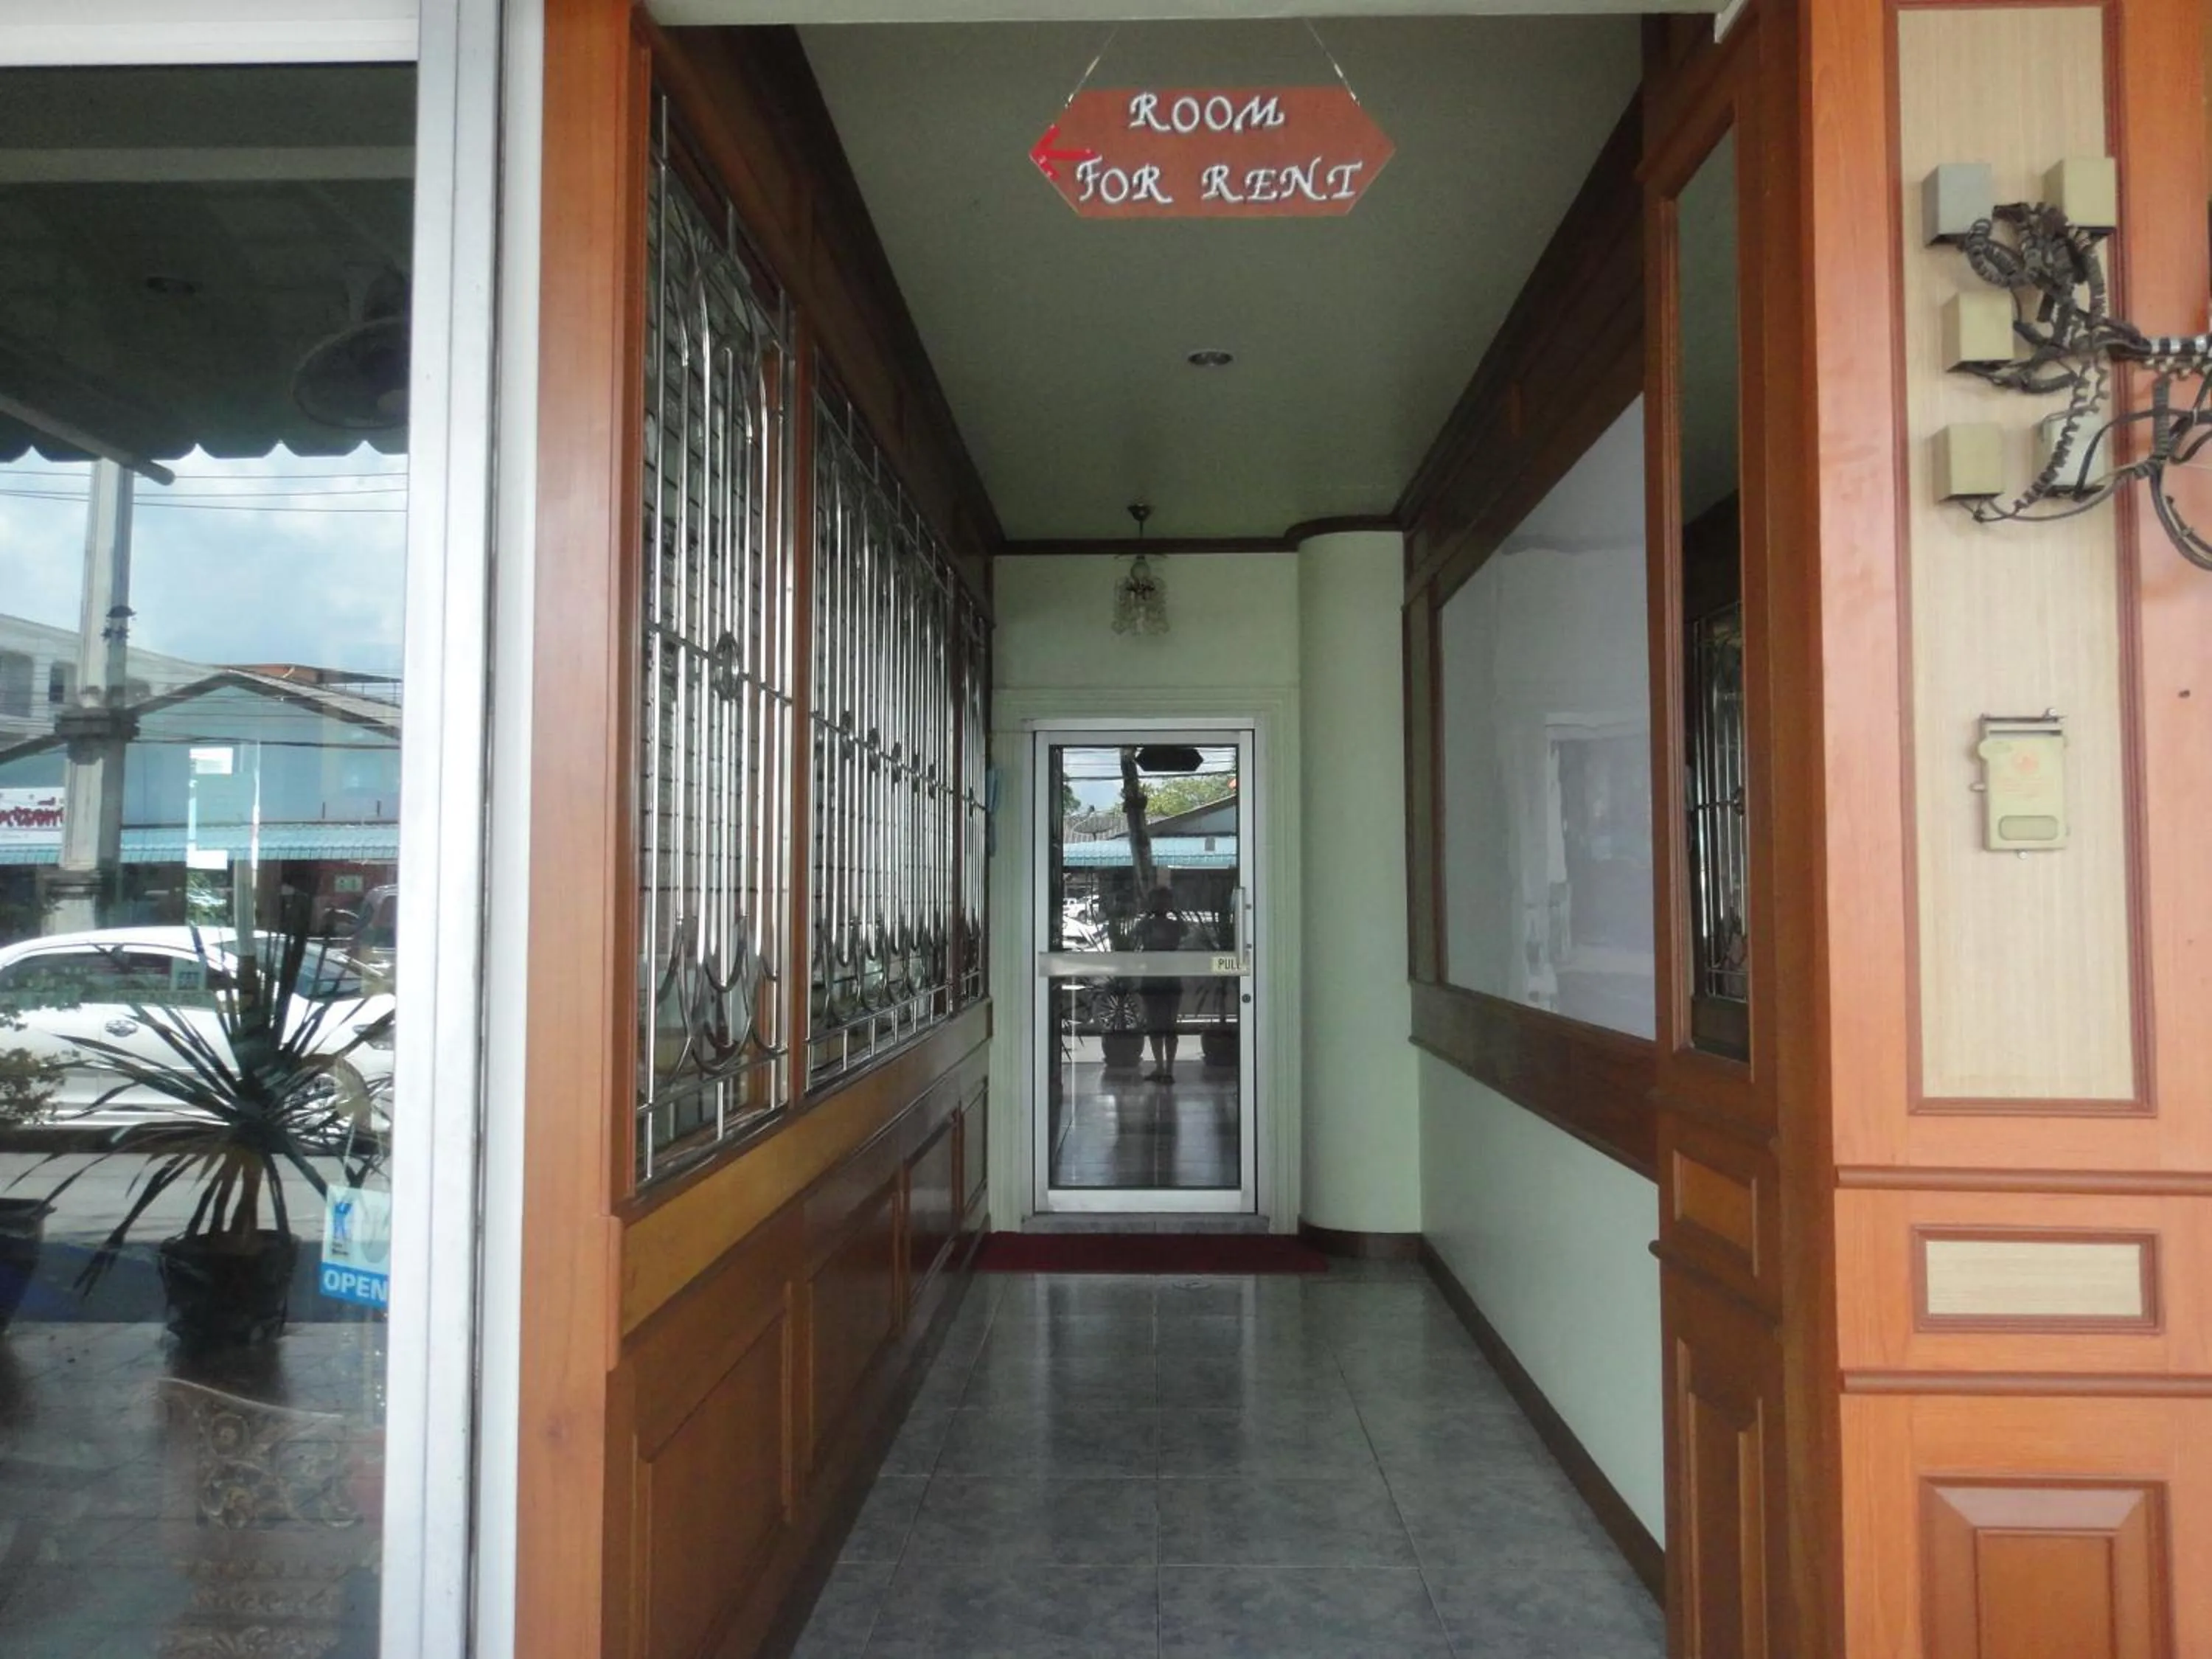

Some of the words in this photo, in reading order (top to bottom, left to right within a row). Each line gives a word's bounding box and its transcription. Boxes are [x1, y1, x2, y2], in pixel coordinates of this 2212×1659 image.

[1129, 91, 1284, 133] ROOM
[1076, 155, 1173, 204] FOR
[1201, 156, 1363, 202] RENT
[323, 1270, 388, 1301] OPEN
